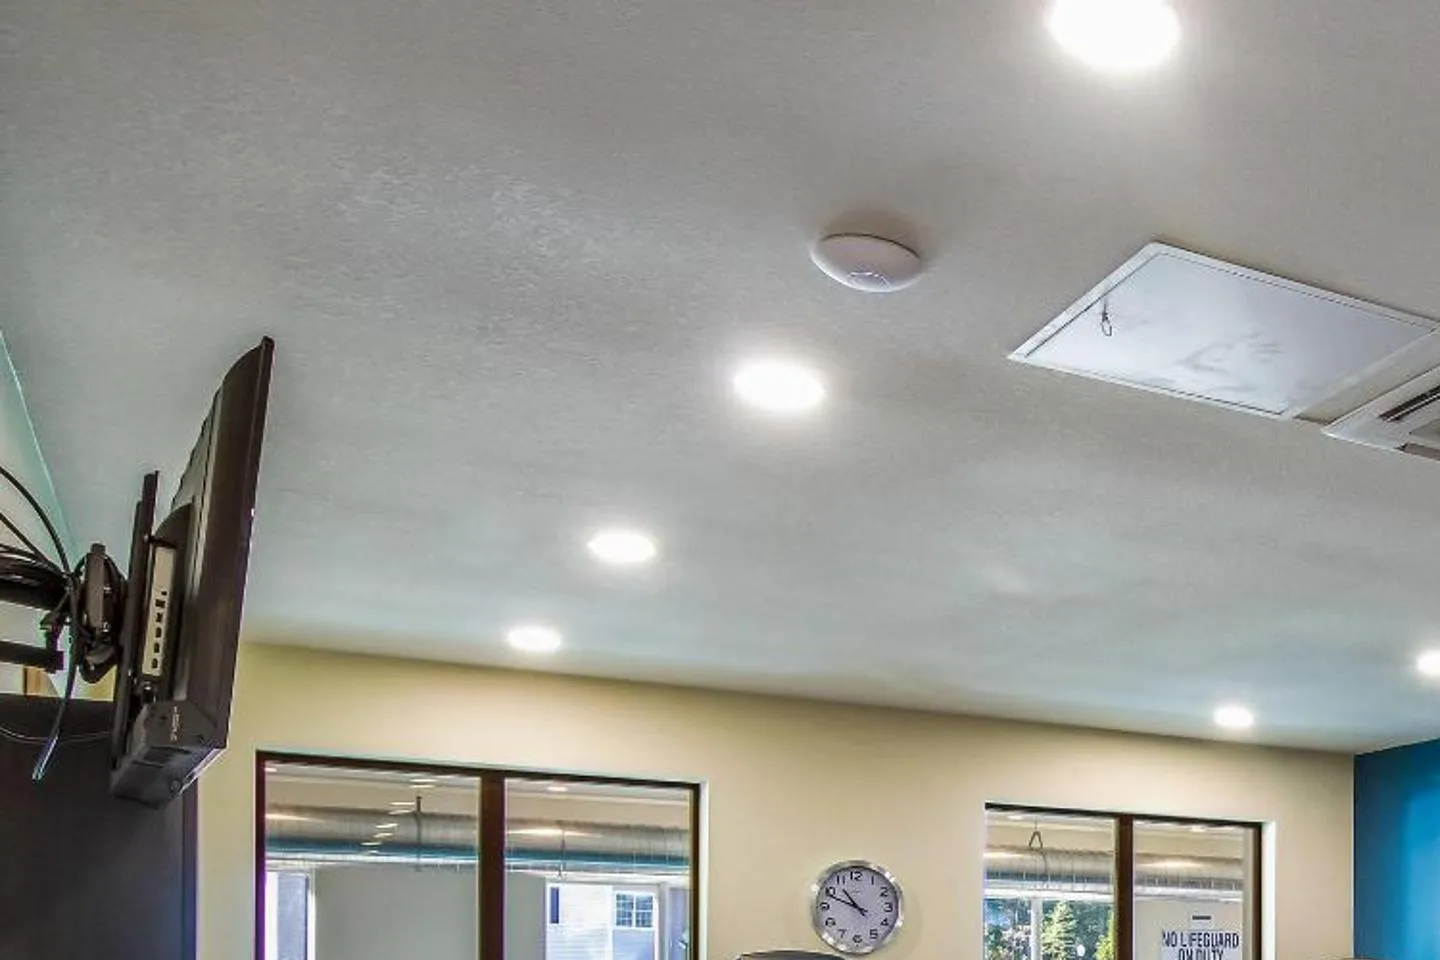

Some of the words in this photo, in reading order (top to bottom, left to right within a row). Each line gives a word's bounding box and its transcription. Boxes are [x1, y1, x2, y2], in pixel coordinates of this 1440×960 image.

[849, 871, 862, 881] 12
[880, 887, 889, 897] 2
[884, 903, 893, 912] 3
[880, 917, 889, 926] 4
[838, 929, 846, 938] 7
[869, 929, 879, 939] 5
[1162, 931, 1178, 948] NO
[1180, 932, 1239, 948] LIFEGUARD
